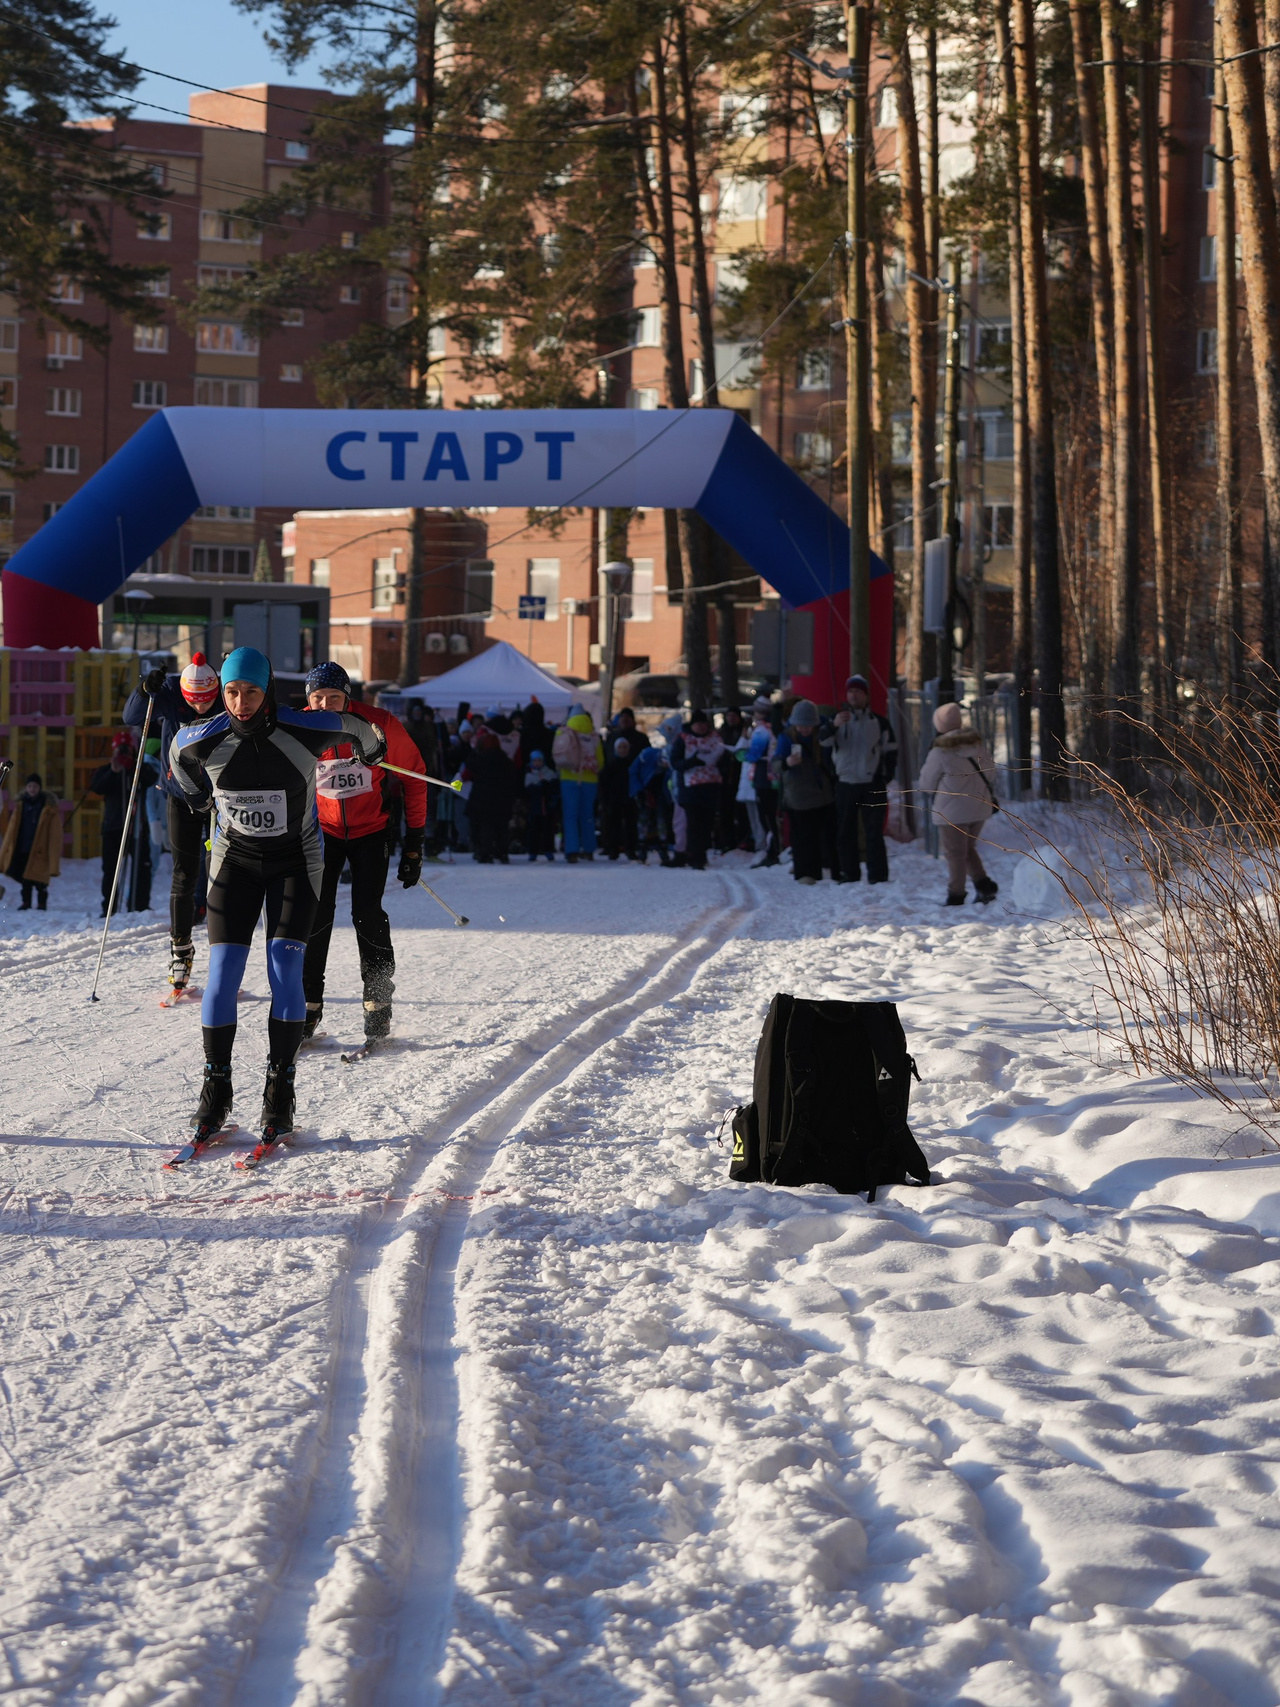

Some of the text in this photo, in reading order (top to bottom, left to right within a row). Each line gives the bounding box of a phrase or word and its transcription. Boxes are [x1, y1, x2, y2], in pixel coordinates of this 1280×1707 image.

[326, 431, 575, 481] СТАРТ
[328, 773, 363, 788] 7561
[228, 807, 275, 829] 7009
